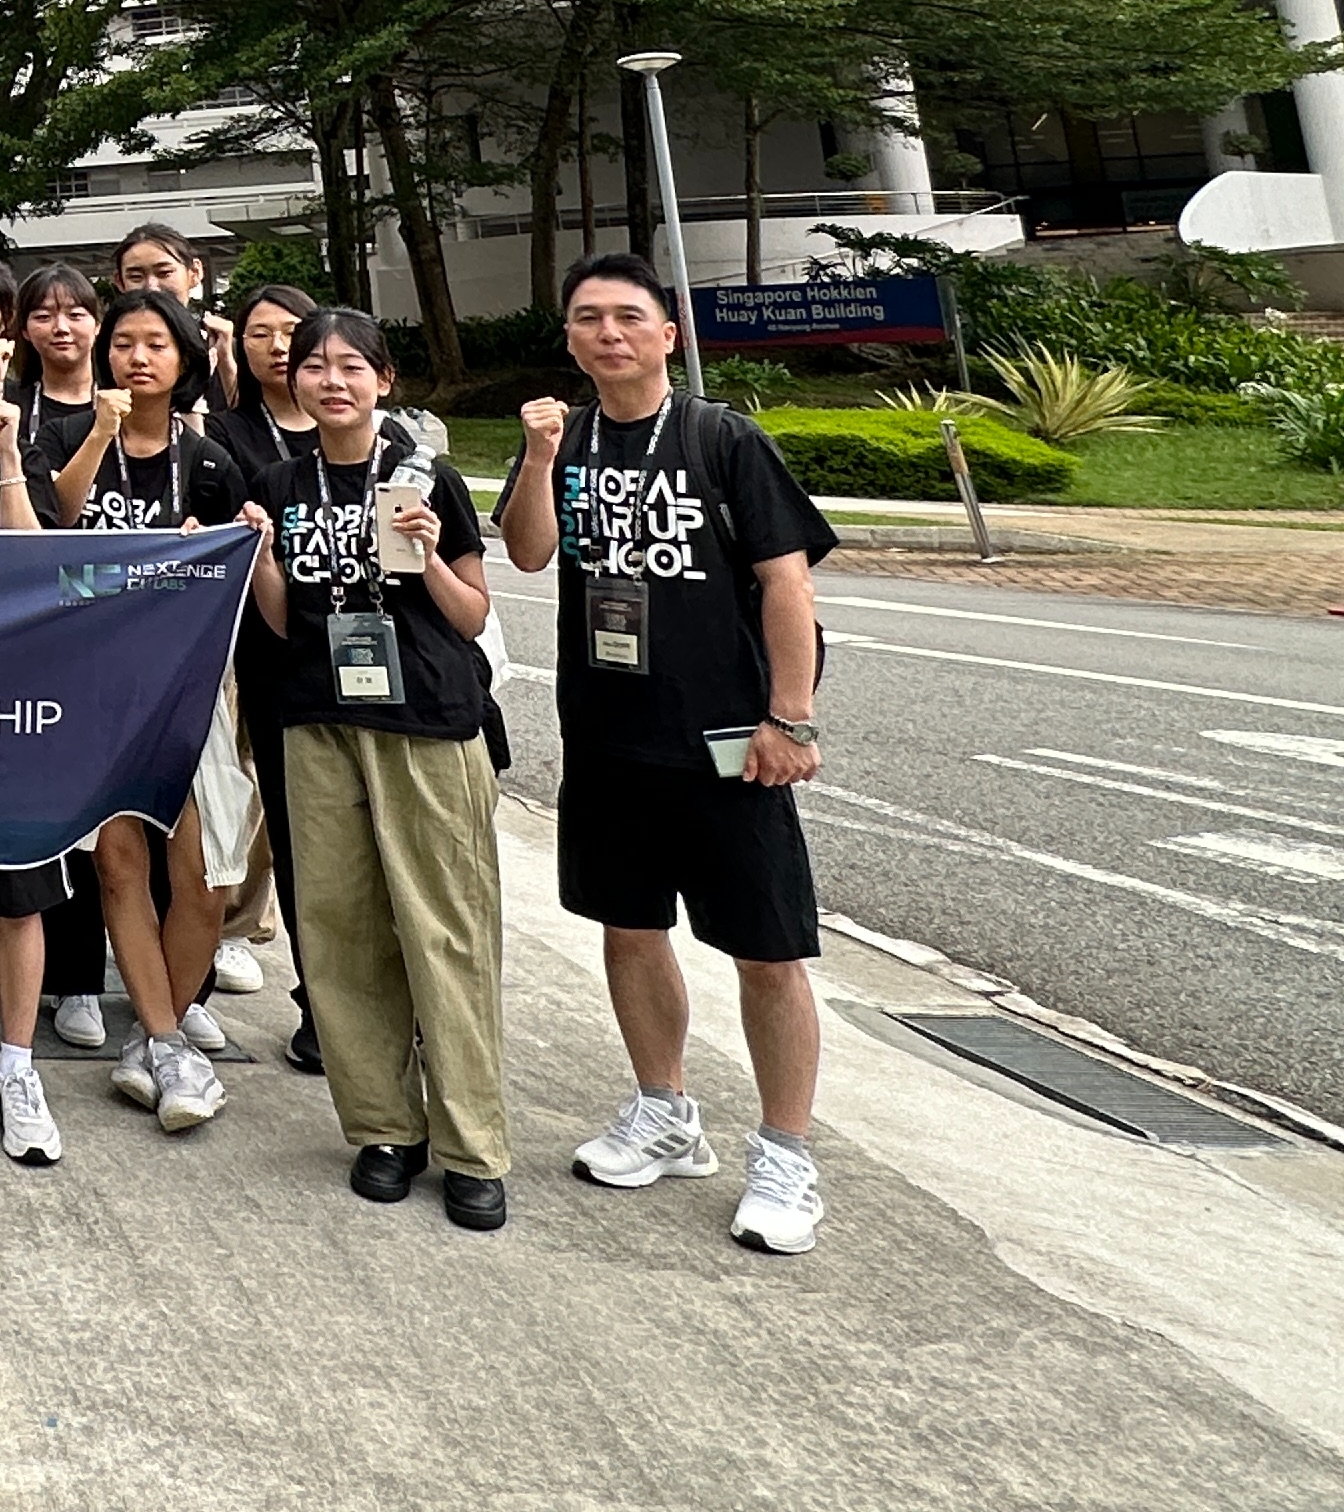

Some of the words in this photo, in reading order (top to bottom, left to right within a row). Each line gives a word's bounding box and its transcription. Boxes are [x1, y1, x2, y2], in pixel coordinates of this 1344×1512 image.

[716, 290, 802, 306] Singapore
[807, 285, 877, 301] Hokkien
[715, 307, 758, 324] Huay
[763, 306, 807, 320] Kuan
[811, 303, 884, 320] Building
